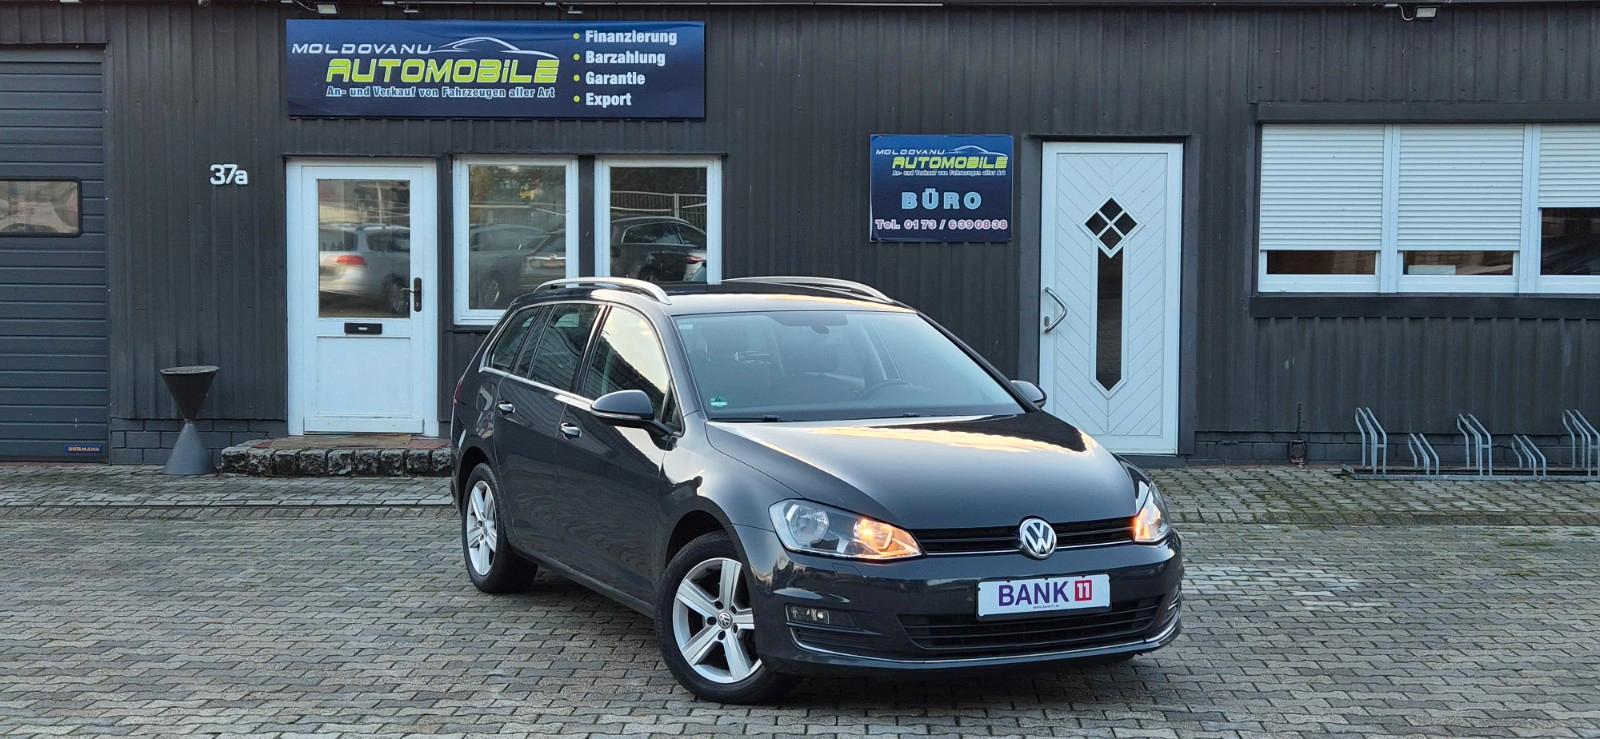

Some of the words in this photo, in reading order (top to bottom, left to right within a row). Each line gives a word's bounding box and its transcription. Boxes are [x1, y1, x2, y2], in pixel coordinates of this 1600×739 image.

[585, 30, 678, 46] Finanzierung
[291, 43, 432, 54] MOLDOVANU
[585, 50, 666, 67] Barzahlung
[585, 71, 646, 85] Garantie
[326, 86, 347, 97] An-
[349, 86, 371, 97] und
[372, 86, 416, 97] Verkauf
[418, 88, 439, 97] von
[441, 86, 506, 99] Fahrzeugen
[508, 87, 535, 98] aller
[537, 87, 556, 98] Art
[585, 92, 632, 108] Export
[210, 163, 248, 185] 37a
[901, 188, 982, 210] BÜRO
[875, 219, 901, 230] Tel.
[904, 219, 937, 230] 0173
[939, 219, 946, 230] /
[948, 219, 1008, 230] 6390838
[1020, 518, 1057, 558] VW
[998, 581, 1070, 607] BANK
[1076, 582, 1091, 599] 11
